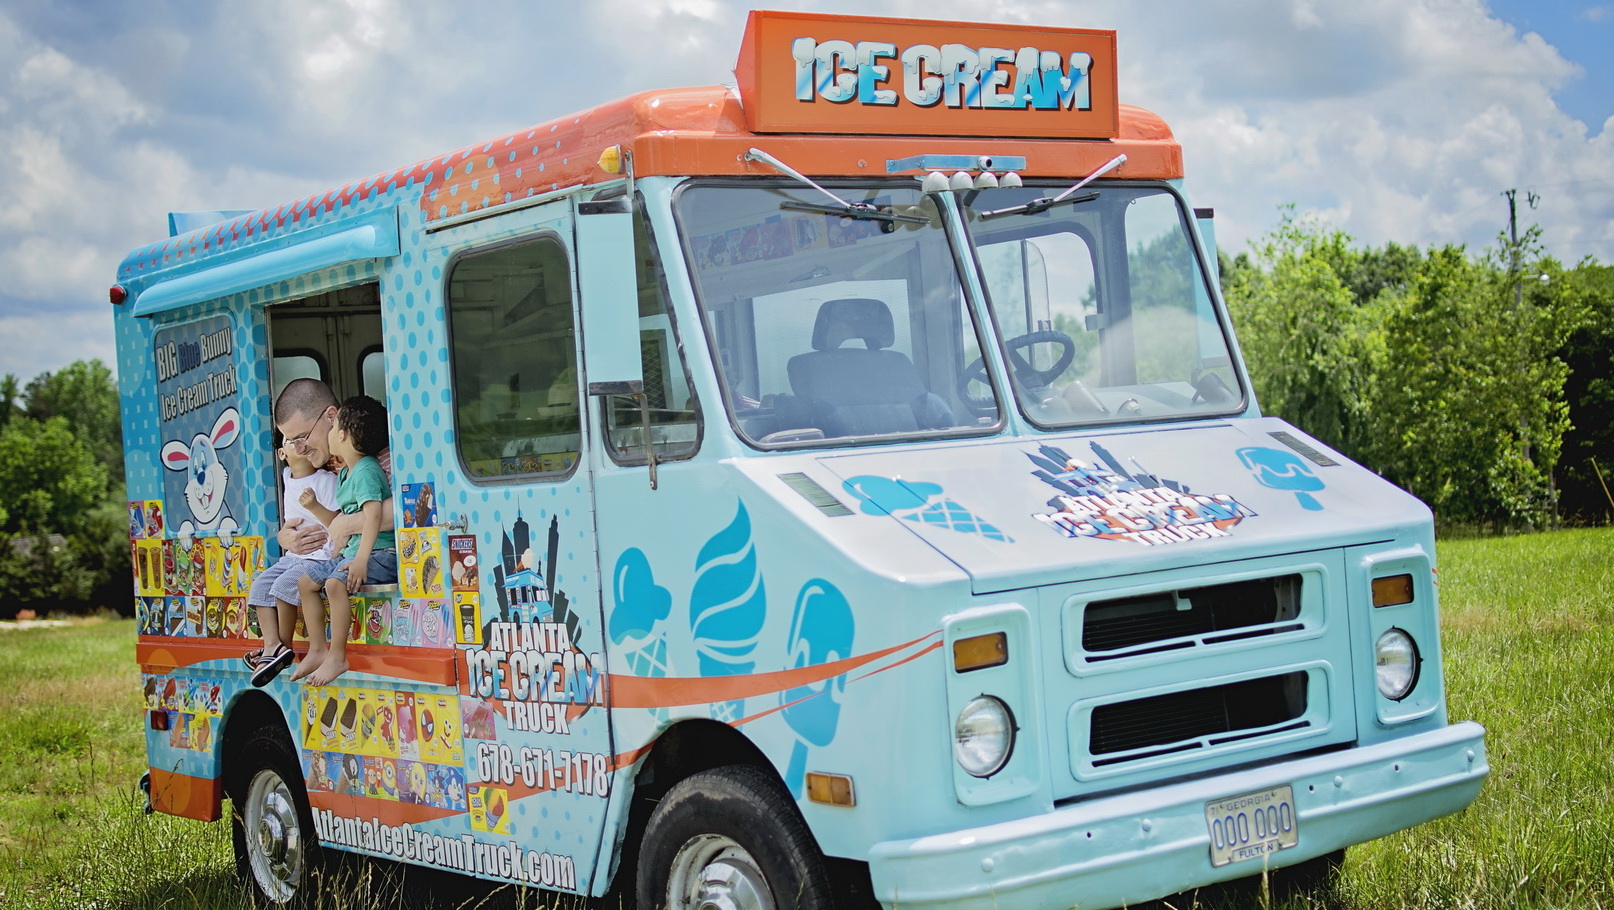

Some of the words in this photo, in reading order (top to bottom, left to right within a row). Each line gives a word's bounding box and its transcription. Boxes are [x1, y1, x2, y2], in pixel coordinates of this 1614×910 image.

[792, 37, 897, 105] ICE
[901, 44, 1093, 111] CREAM
[156, 340, 178, 382] BIG
[200, 326, 232, 364] Bunny
[161, 393, 177, 422] Ice
[177, 379, 209, 415] Cream
[207, 364, 237, 403] Truck
[1031, 510, 1128, 538] ICE
[1105, 493, 1259, 532] CREAM
[1057, 486, 1183, 513] ATLANTA
[1121, 522, 1234, 546] TRUCK
[490, 622, 572, 653] ATLANTA
[465, 648, 509, 701] ICE
[508, 650, 603, 705] CREAM
[502, 700, 571, 736] TRUCK
[476, 741, 610, 799] 678-671-7178
[1213, 812, 1249, 849] 000
[1254, 802, 1291, 838] 000
[1226, 794, 1270, 811] GEORGIA
